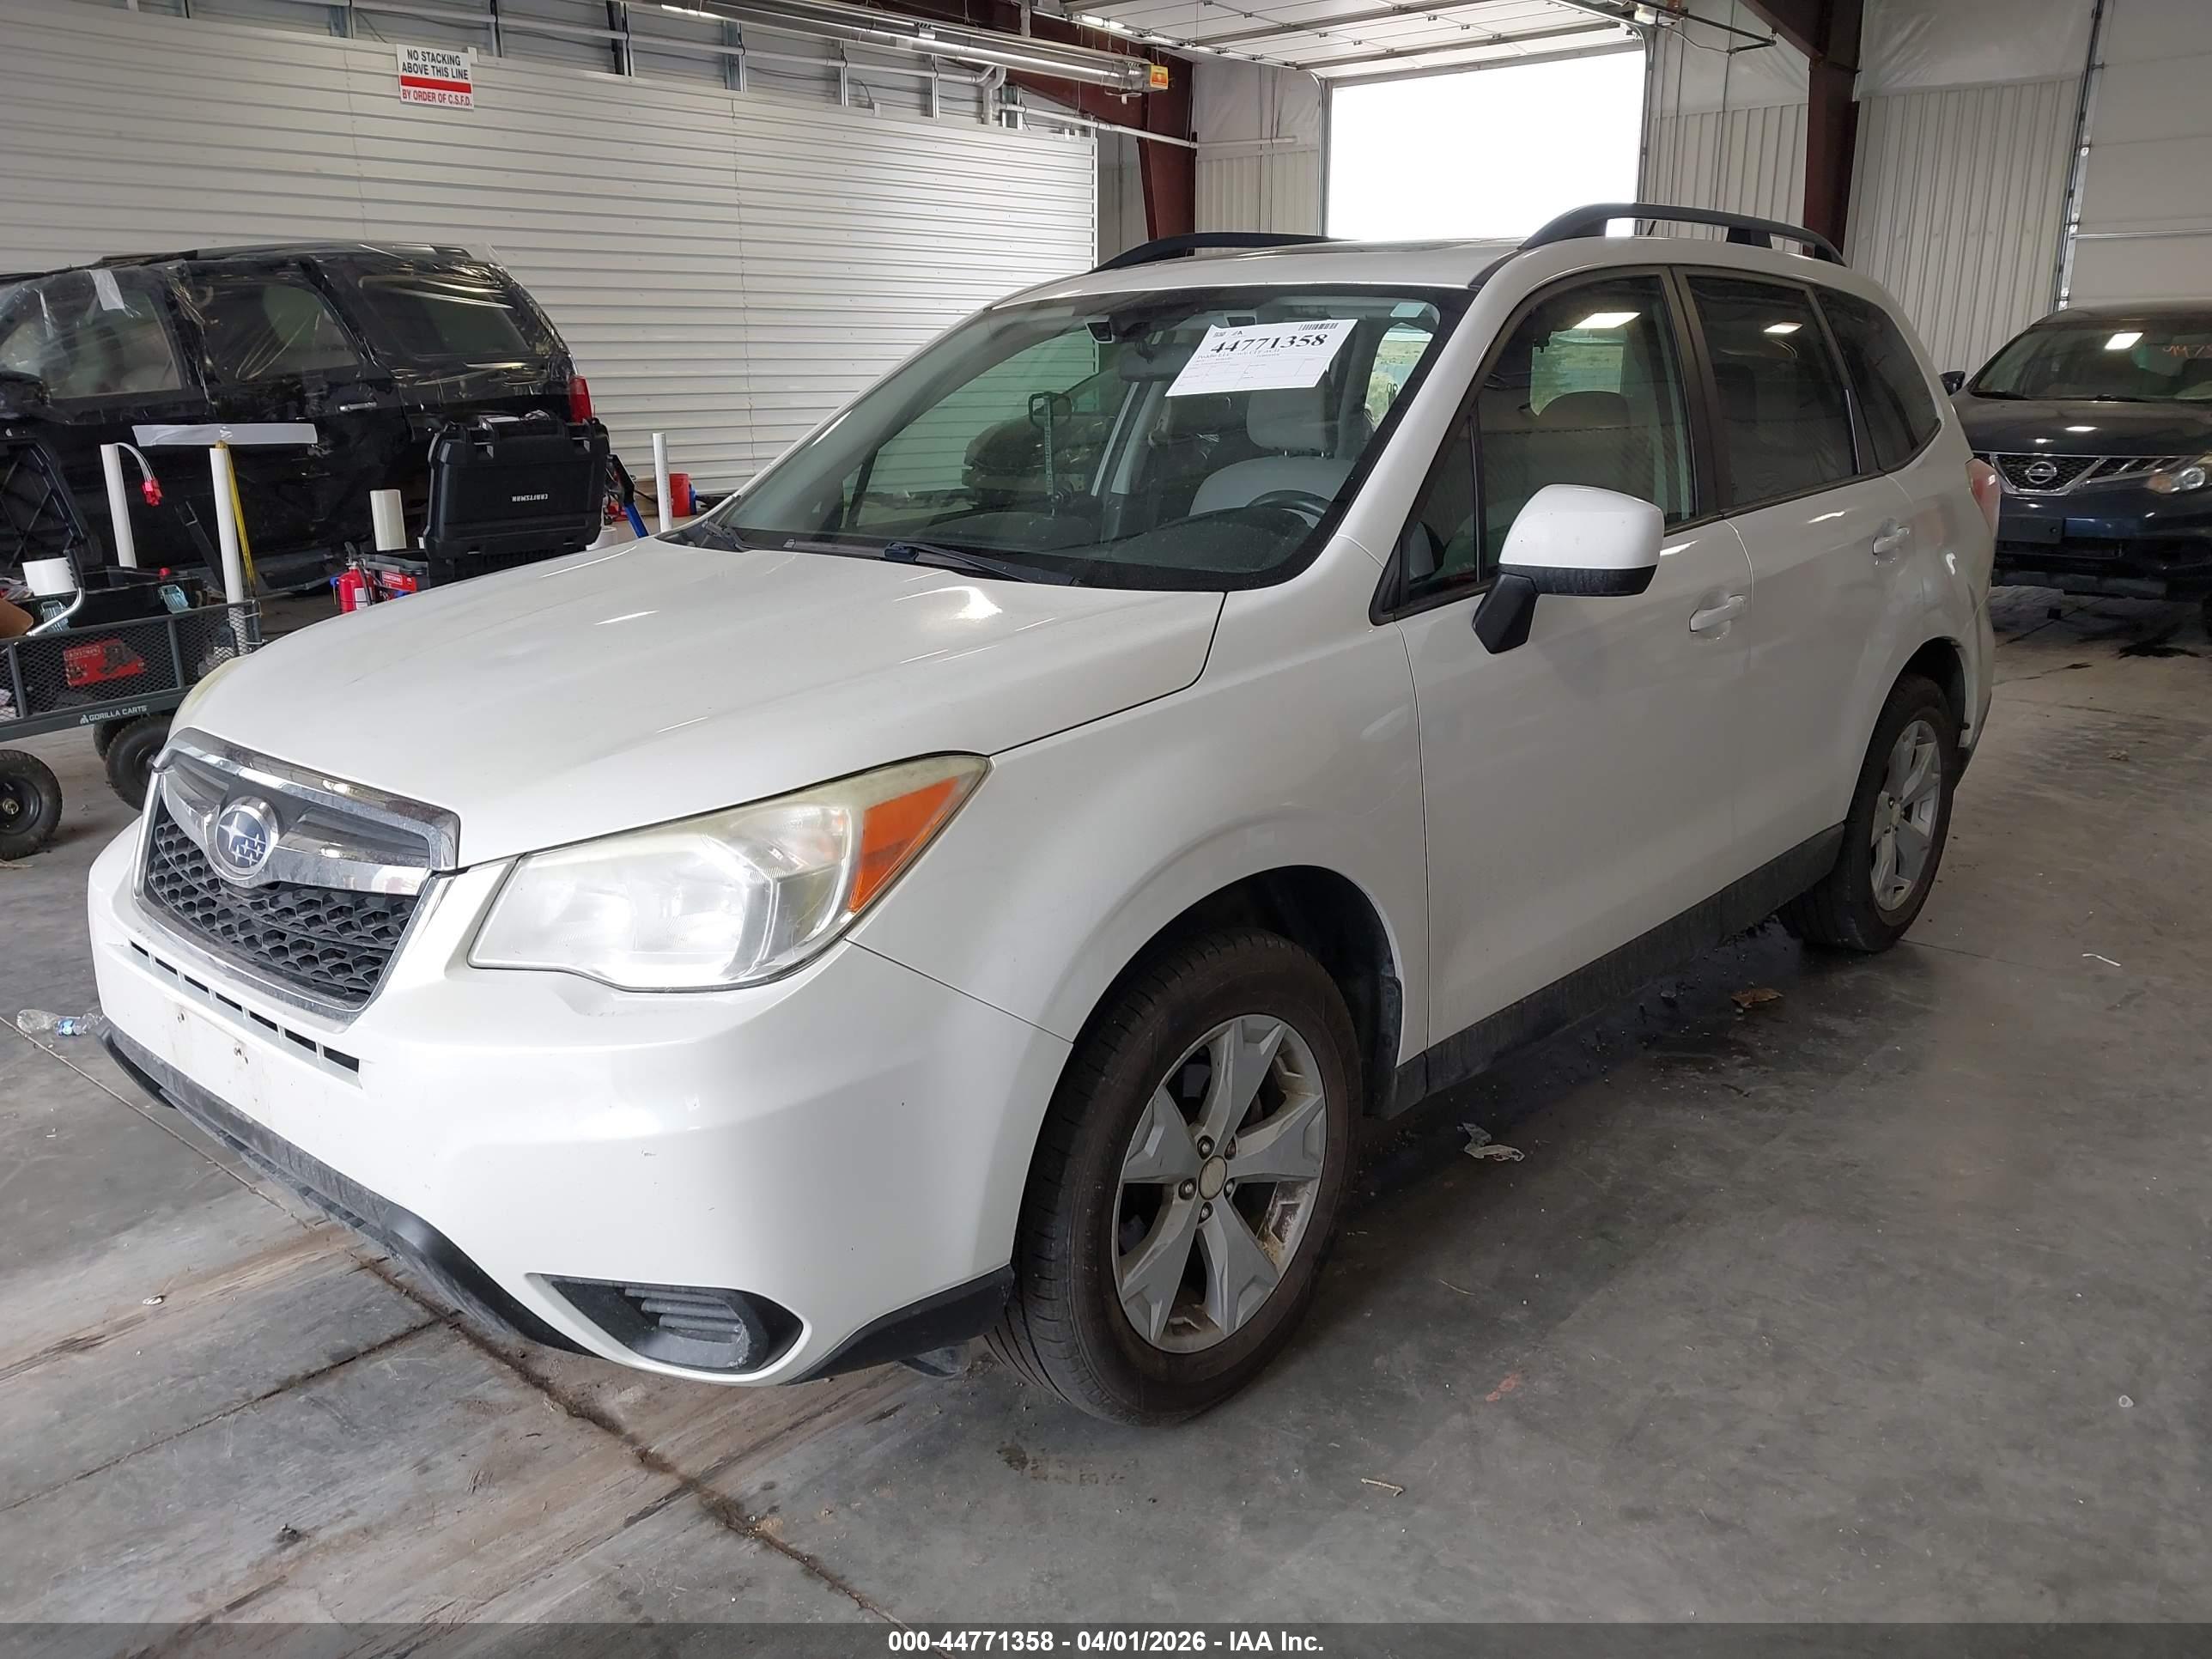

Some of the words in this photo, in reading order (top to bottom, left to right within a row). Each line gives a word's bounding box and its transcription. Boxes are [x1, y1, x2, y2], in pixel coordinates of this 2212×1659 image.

[407, 49, 419, 60] NO
[422, 52, 461, 66] STACKING
[402, 62, 428, 75] ABOVE
[431, 65, 449, 77] THIS
[451, 69, 469, 80] LINE
[403, 89, 410, 100] BY
[413, 90, 436, 103] ORDER
[438, 94, 447, 103] OF
[448, 94, 472, 106] C.S.F.D.
[1211, 334, 1328, 353] 44771358
[88, 710, 120, 721] GORILLA
[122, 705, 148, 715] CARTS
